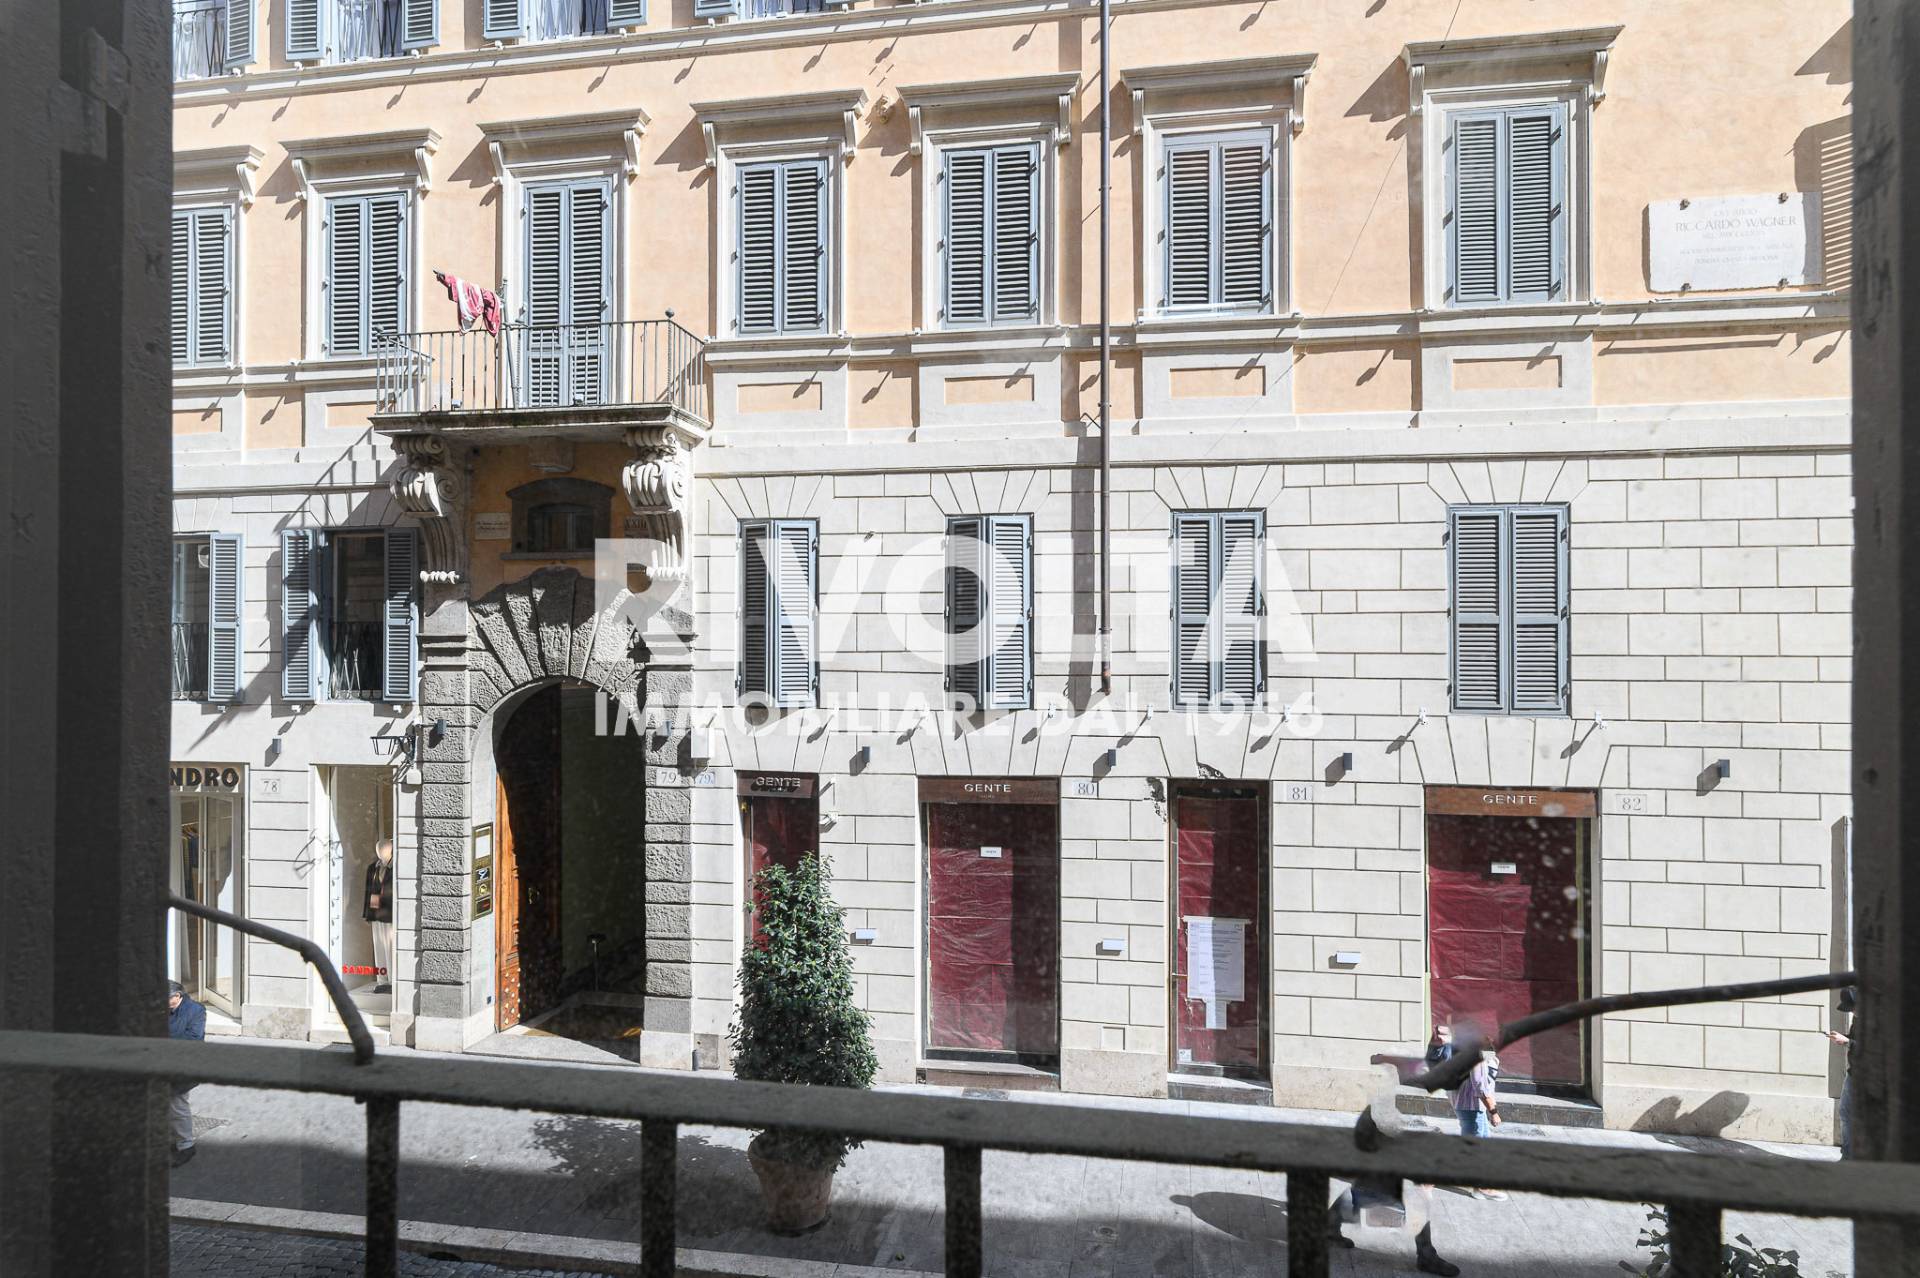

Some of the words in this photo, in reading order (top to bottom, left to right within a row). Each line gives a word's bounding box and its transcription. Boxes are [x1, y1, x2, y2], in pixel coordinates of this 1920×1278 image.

[661, 771, 677, 784] 79
[756, 776, 801, 787] GENTE
[263, 780, 278, 793] 78
[964, 783, 1012, 793] GENTE
[1077, 782, 1095, 795] 80
[1291, 787, 1308, 800] 81
[1483, 794, 1538, 805] GENTE
[1622, 797, 1641, 810] 82
